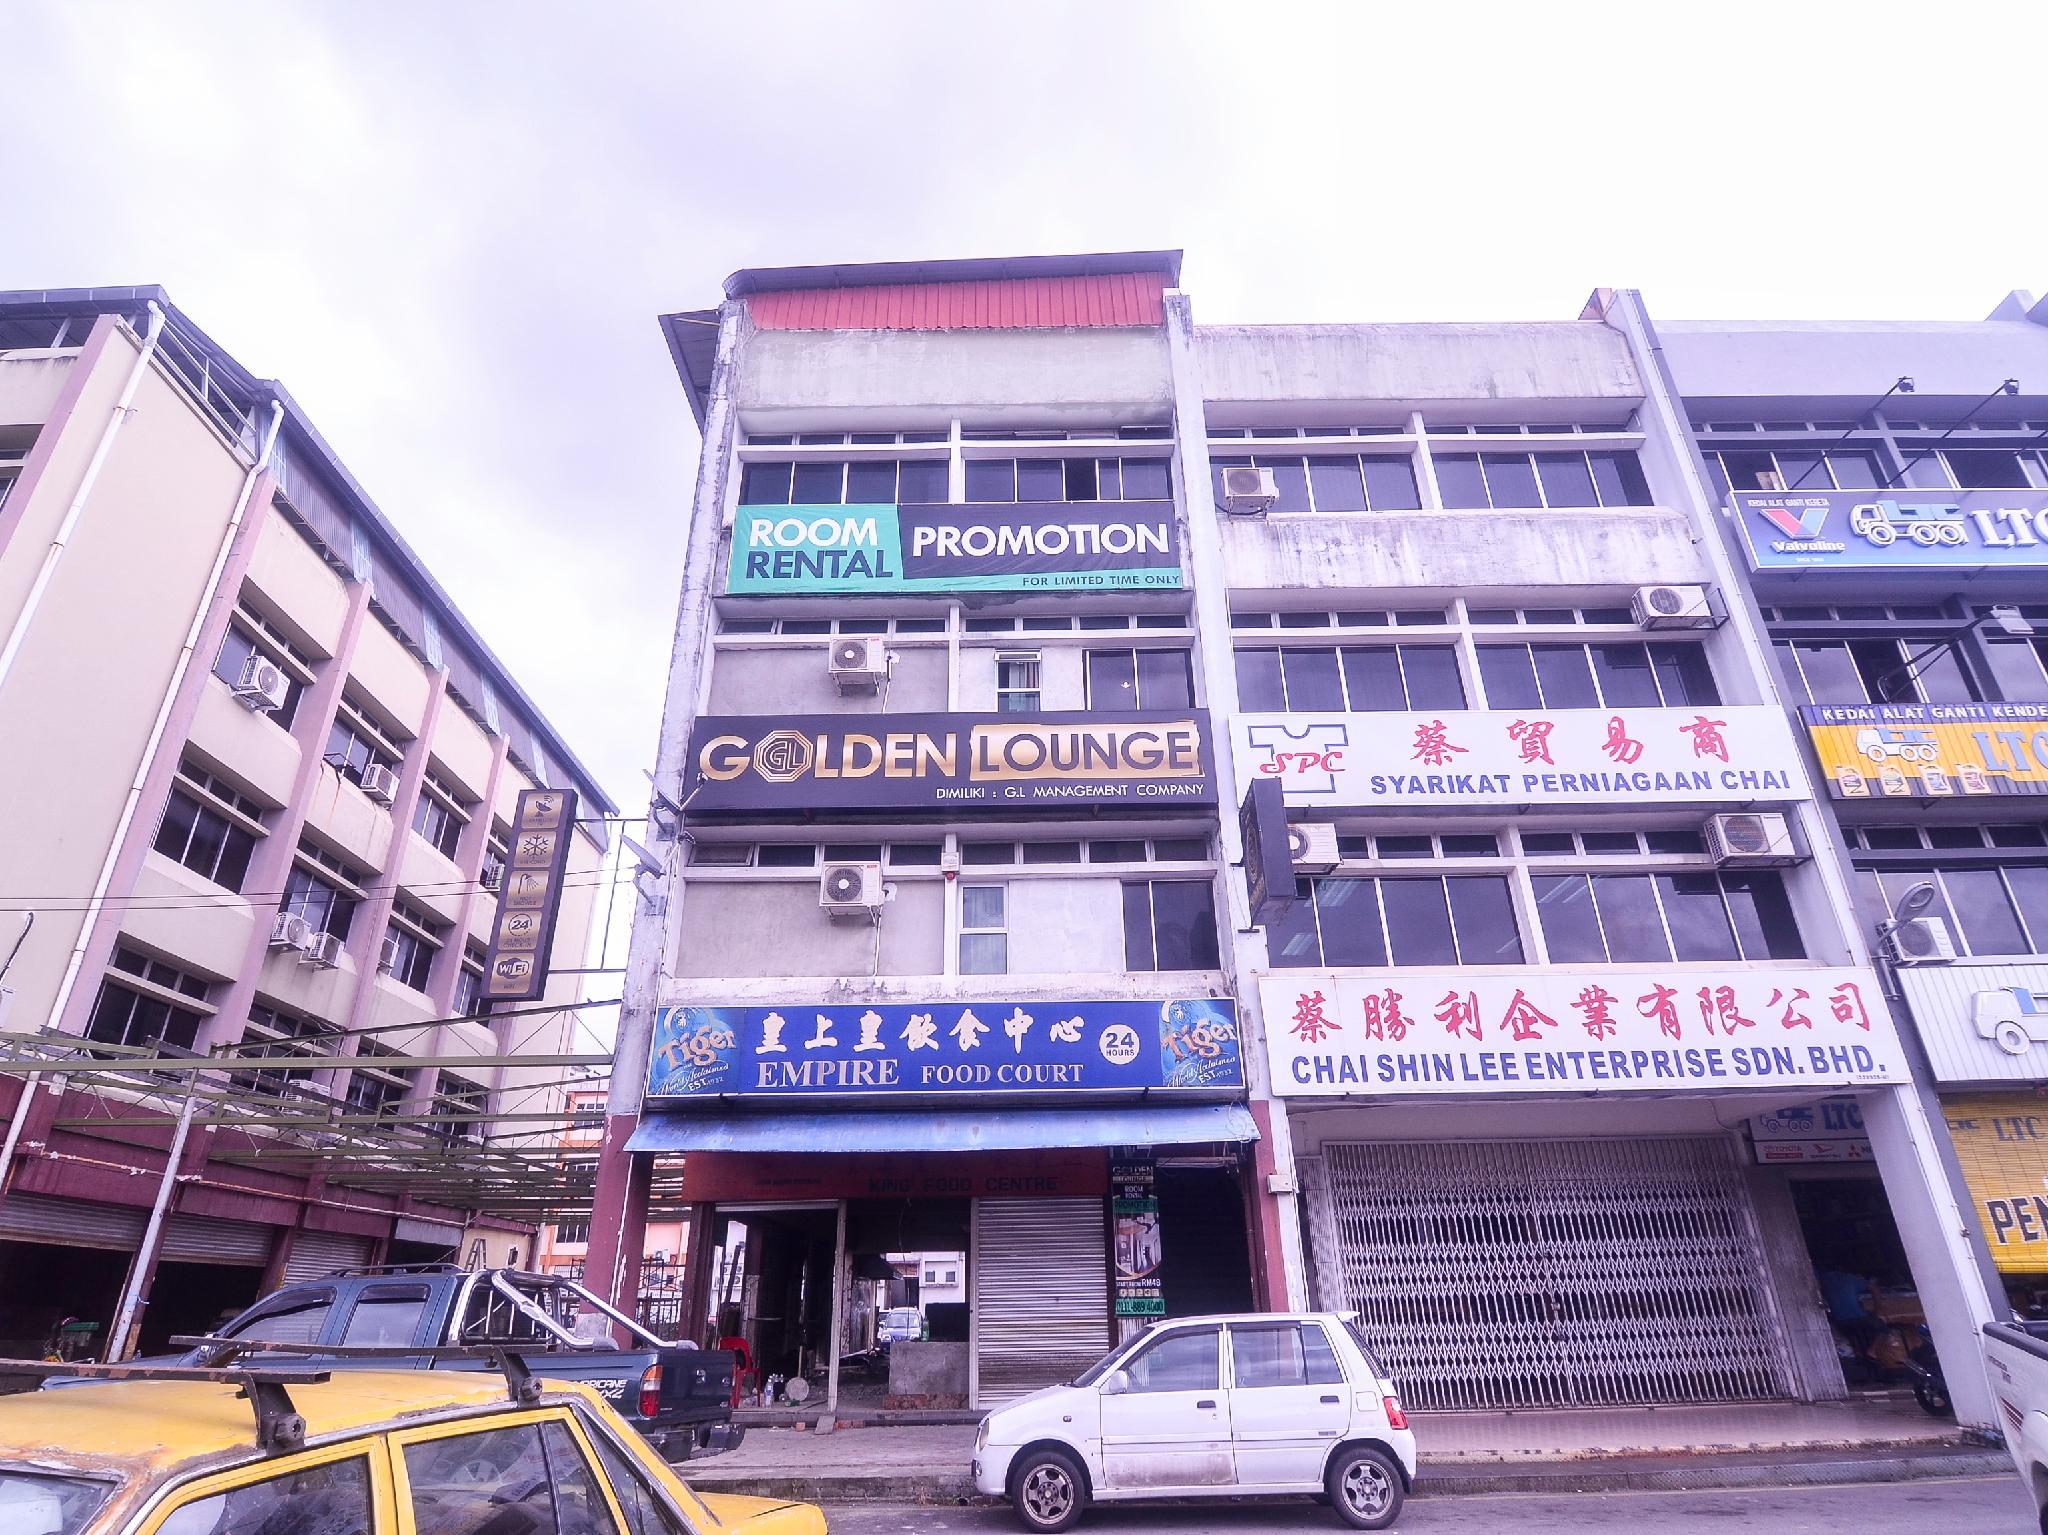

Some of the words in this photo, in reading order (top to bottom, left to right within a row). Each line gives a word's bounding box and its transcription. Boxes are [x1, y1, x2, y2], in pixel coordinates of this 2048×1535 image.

[749, 517, 878, 547] ROOM
[912, 523, 1169, 557] PROMOTION
[1771, 540, 1845, 552] Valvoline
[746, 550, 893, 579] RENTAL
[1022, 577, 1048, 587] FOR
[1054, 576, 1104, 586] LIMITED
[1110, 575, 1139, 585] TIME
[1145, 574, 1180, 585] ONLY
[1822, 708, 1876, 720] KEDAI
[1883, 707, 1924, 719] ALAT
[1932, 706, 1986, 718] GANTI
[979, 731, 1194, 772] LOUNGE
[1410, 715, 1730, 767] 蔡貿易商
[1259, 751, 1347, 774] SPC
[936, 787, 985, 799] DIMILIKI
[1004, 786, 1026, 798] G.L
[1033, 785, 1128, 798] MANAGEMENT
[1136, 784, 1205, 797] COMPANY
[1370, 775, 1511, 795] SYARIKAT
[1522, 771, 1713, 793] PERNIAGAAN
[1721, 770, 1791, 790] CHAI
[510, 919, 530, 930] 24
[1289, 982, 1871, 1044] 蔡勝利企業有限公司
[657, 1025, 737, 1071] Tiger
[1105, 1032, 1135, 1049] 24
[1106, 1049, 1135, 1057] HOURS
[1161, 1019, 1238, 1060] Tiger
[755, 1058, 900, 1088] EMPIRE
[921, 1064, 991, 1084] FOOD
[997, 1063, 1084, 1083] COURT
[1291, 1054, 1369, 1084] CHAI
[1377, 1053, 1455, 1082] SHIN
[1459, 1052, 1520, 1081] LEE
[1525, 1048, 1727, 1081] ENTERPRISE
[1731, 1046, 1805, 1076] SDN.
[1807, 1045, 1887, 1074] BHD.
[1821, 1102, 1864, 1131] LTC
[985, 1176, 1057, 1191] CENTRE
